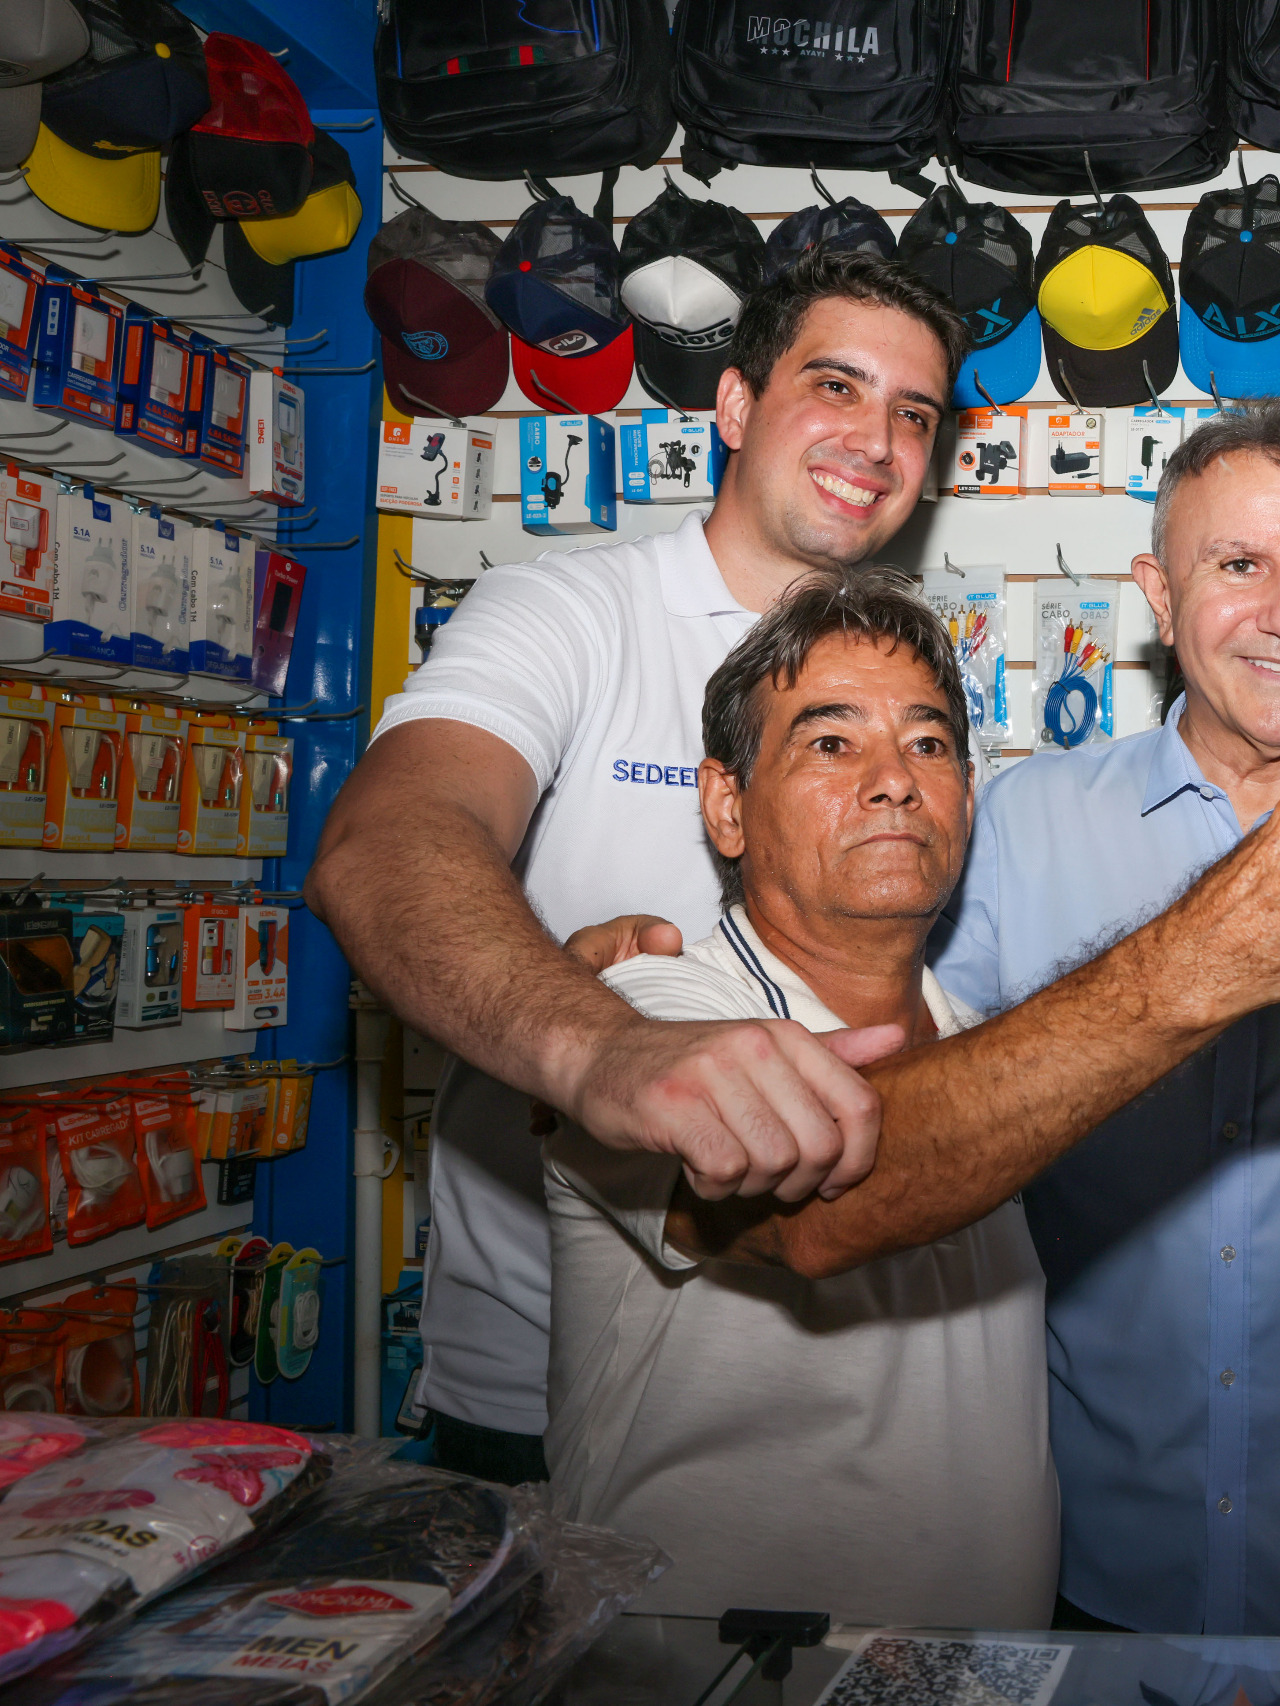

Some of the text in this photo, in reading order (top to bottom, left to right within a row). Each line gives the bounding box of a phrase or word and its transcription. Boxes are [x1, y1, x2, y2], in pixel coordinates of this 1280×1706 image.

[747, 15, 880, 55] MOCHILA
[1130, 308, 1163, 336] adidas
[553, 333, 585, 351] FILA
[73, 526, 91, 539] 5.1A
[140, 544, 156, 556] 5.1A
[209, 556, 223, 567] 5.1A
[929, 602, 957, 611] CABO
[1041, 601, 1062, 610] SÉRIE
[190, 610, 197, 623] 1M
[1041, 610, 1070, 619] CABO
[264, 987, 286, 999] 3.4A
[68, 1132, 84, 1147] KIT
[11, 1518, 160, 1549] LINDAS
[247, 1635, 361, 1661] MEN
[232, 1653, 335, 1674] MEIAS
